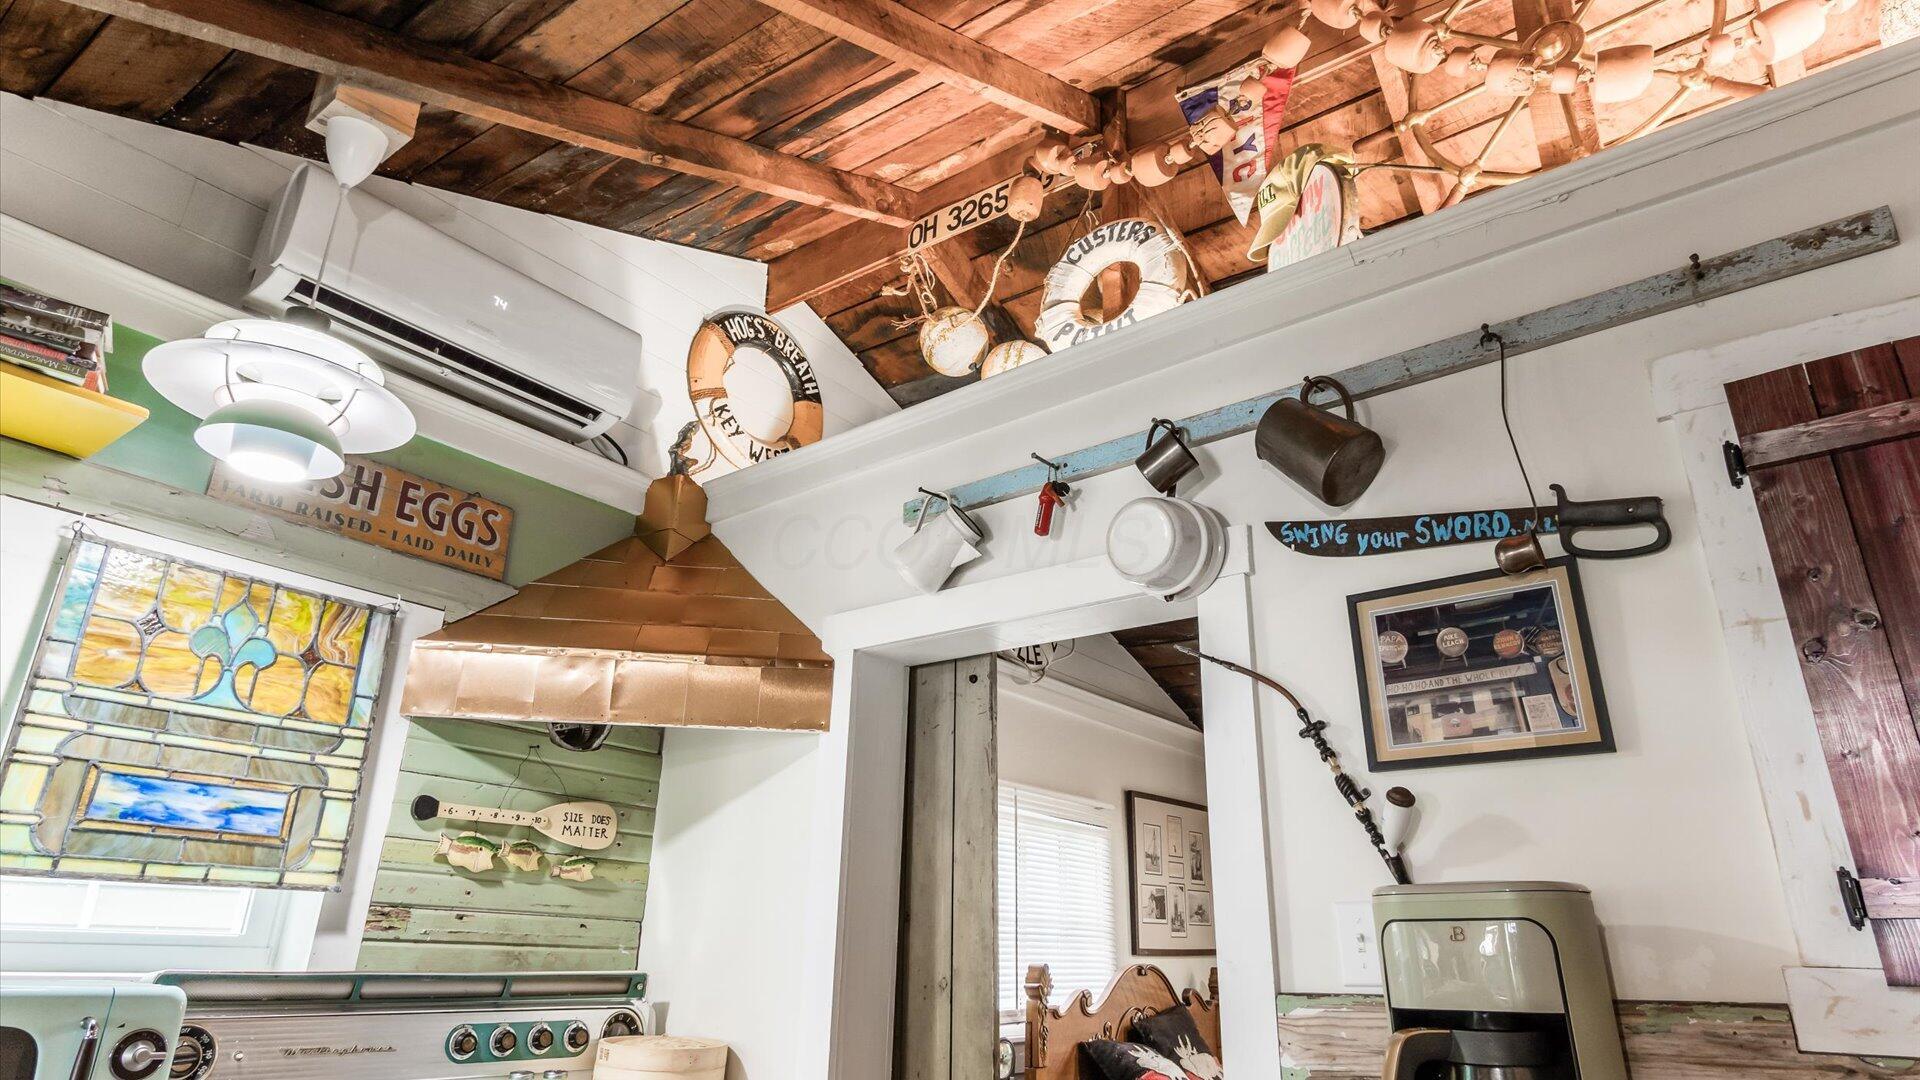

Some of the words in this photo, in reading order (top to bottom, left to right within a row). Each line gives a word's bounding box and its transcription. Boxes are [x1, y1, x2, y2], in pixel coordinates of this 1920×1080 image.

[908, 217, 938, 249] OH
[946, 185, 1010, 231] 3265
[1066, 220, 1157, 264] CUSTERS
[725, 315, 766, 342] HOG'S
[774, 329, 819, 395] BREATH
[714, 404, 744, 437] KEY
[222, 479, 283, 509] FARM
[295, 501, 373, 534] RAISED
[391, 527, 435, 552] LAID
[444, 545, 495, 568] DAILY
[395, 480, 500, 548] EGGS
[1280, 522, 1348, 549] SWING
[1357, 530, 1409, 555] your
[561, 825, 609, 839] MATTER
[562, 811, 584, 823] SIZE
[591, 814, 612, 826] DOES
